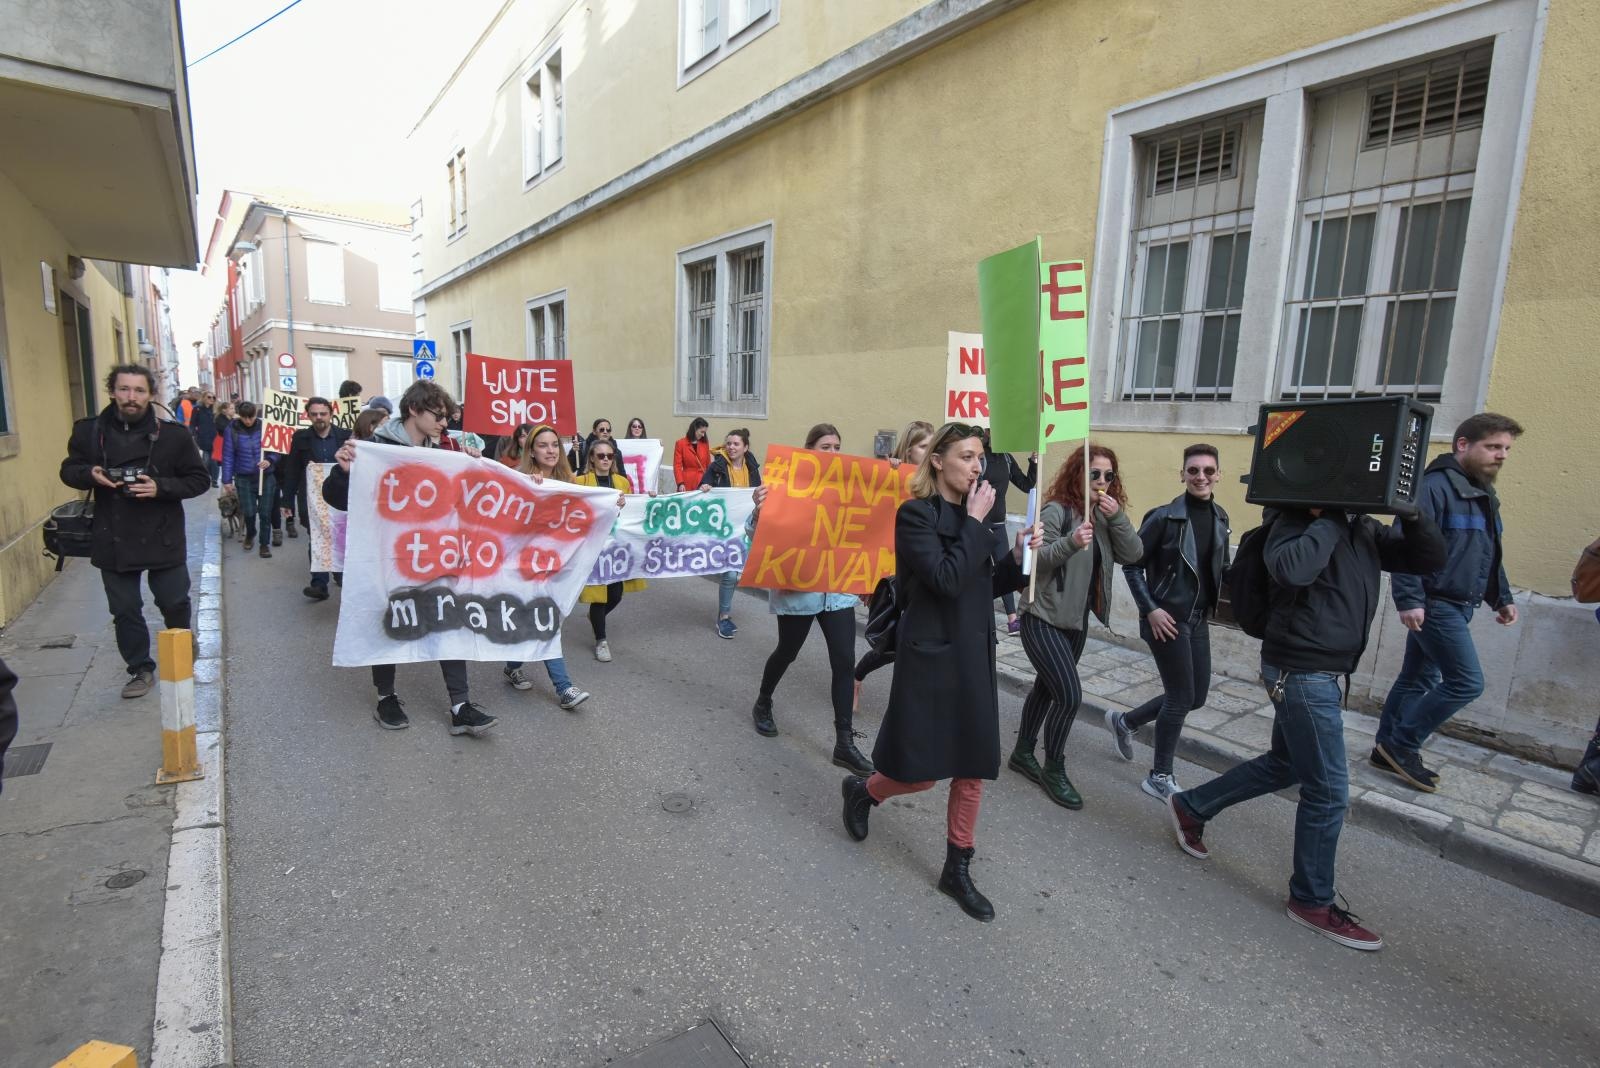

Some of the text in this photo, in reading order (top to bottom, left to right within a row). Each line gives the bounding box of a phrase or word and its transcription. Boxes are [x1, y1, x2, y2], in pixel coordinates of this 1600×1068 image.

[481, 361, 558, 395] LJUTE
[265, 404, 313, 427] POVIJE
[274, 393, 298, 411] DAN
[343, 399, 361, 415] JE
[490, 399, 557, 427] SMO!
[947, 390, 990, 418] KR
[1369, 433, 1384, 471] JOYO
[383, 472, 588, 534] to vam je
[811, 504, 871, 549] NE
[405, 532, 555, 574] tako u
[390, 587, 554, 632] mraku
